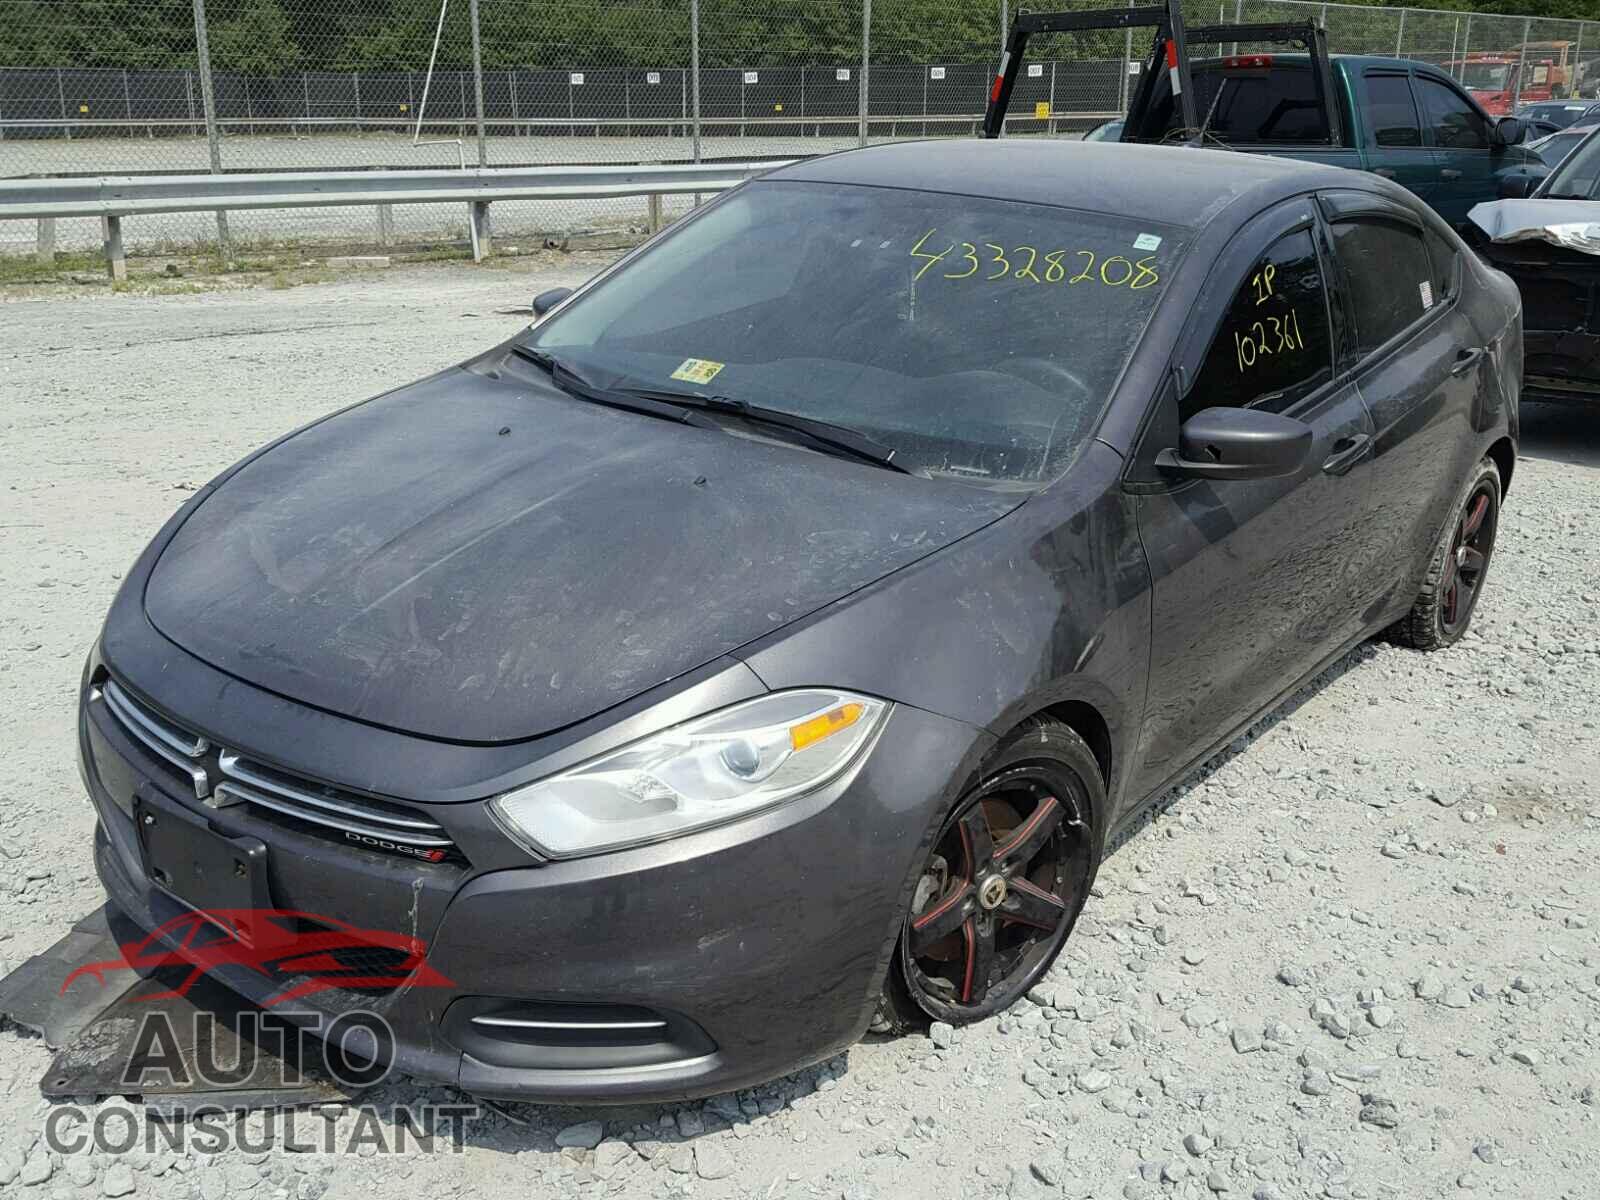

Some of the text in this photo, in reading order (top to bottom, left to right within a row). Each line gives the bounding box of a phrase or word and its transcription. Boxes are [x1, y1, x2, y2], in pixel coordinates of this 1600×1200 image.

[910, 228, 1159, 289] 43328208
[1234, 308, 1304, 373] 102361
[345, 831, 434, 860] DODGE
